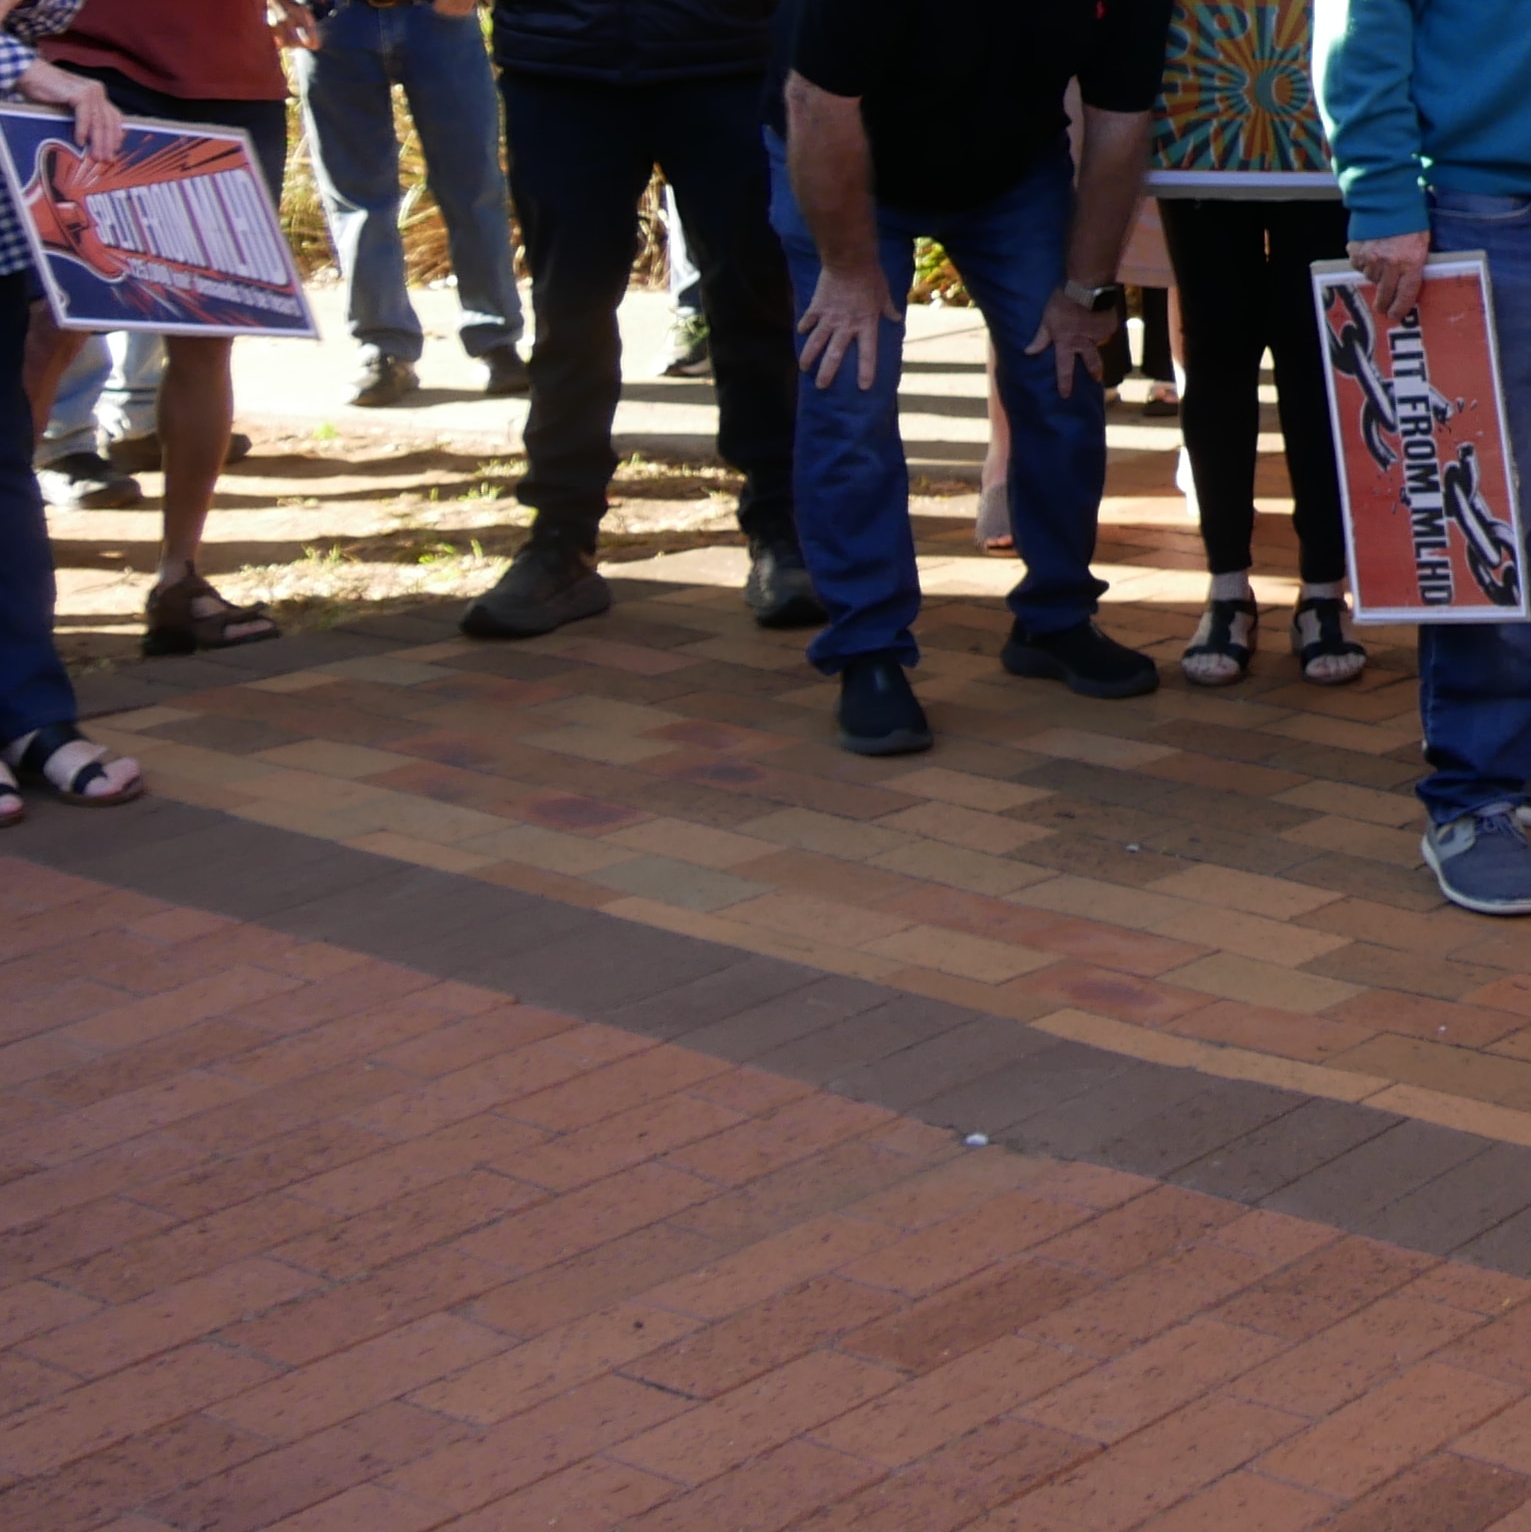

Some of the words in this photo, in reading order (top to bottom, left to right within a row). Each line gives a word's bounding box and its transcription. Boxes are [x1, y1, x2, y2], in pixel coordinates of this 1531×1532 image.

[1154, 63, 1312, 117] FRO
[1388, 306, 1428, 384] PLIT
[1397, 395, 1441, 495] FROM
[1411, 507, 1454, 606] MLHD
